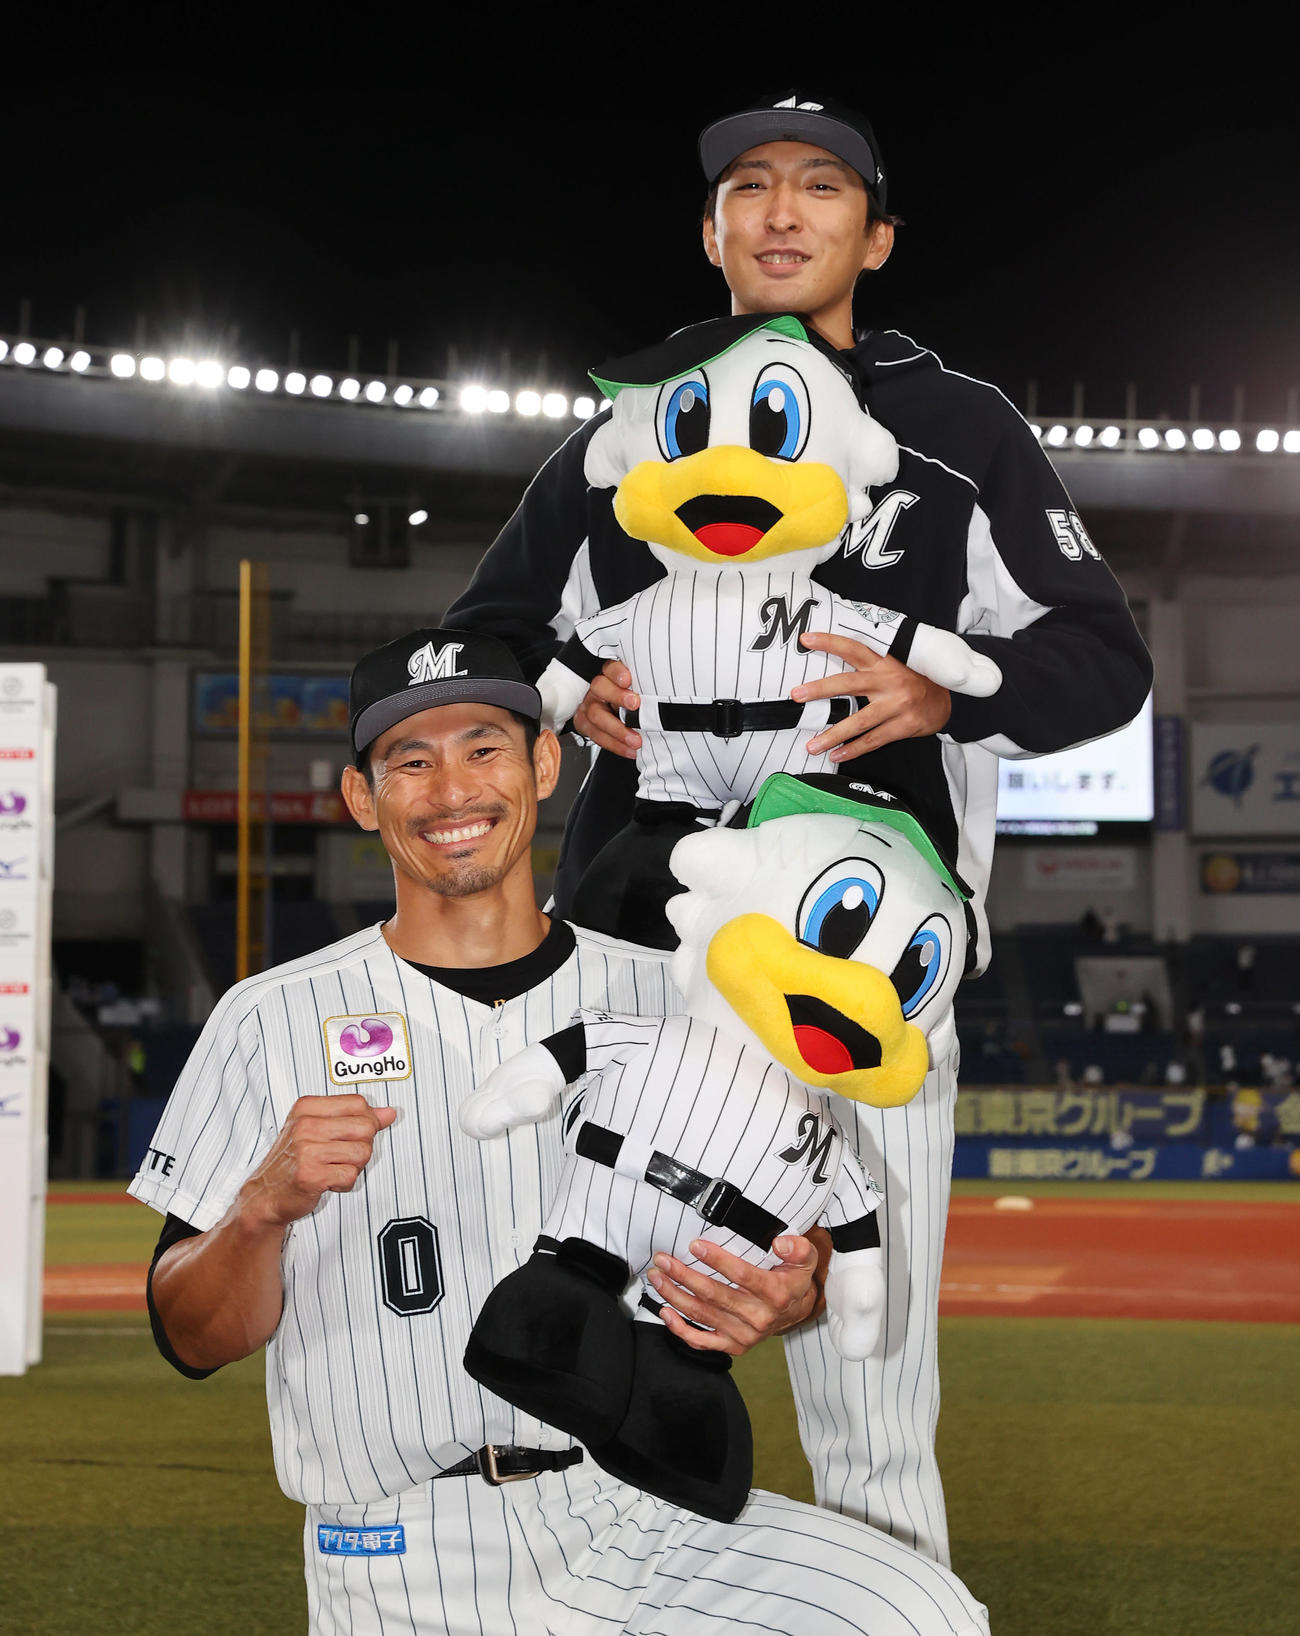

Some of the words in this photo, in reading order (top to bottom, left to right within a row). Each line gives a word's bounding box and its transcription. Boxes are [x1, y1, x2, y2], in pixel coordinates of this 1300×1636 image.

[1045, 508, 1101, 561] 58
[747, 592, 821, 656] M
[334, 1056, 406, 1077] GungHo
[149, 1147, 176, 1177] TE
